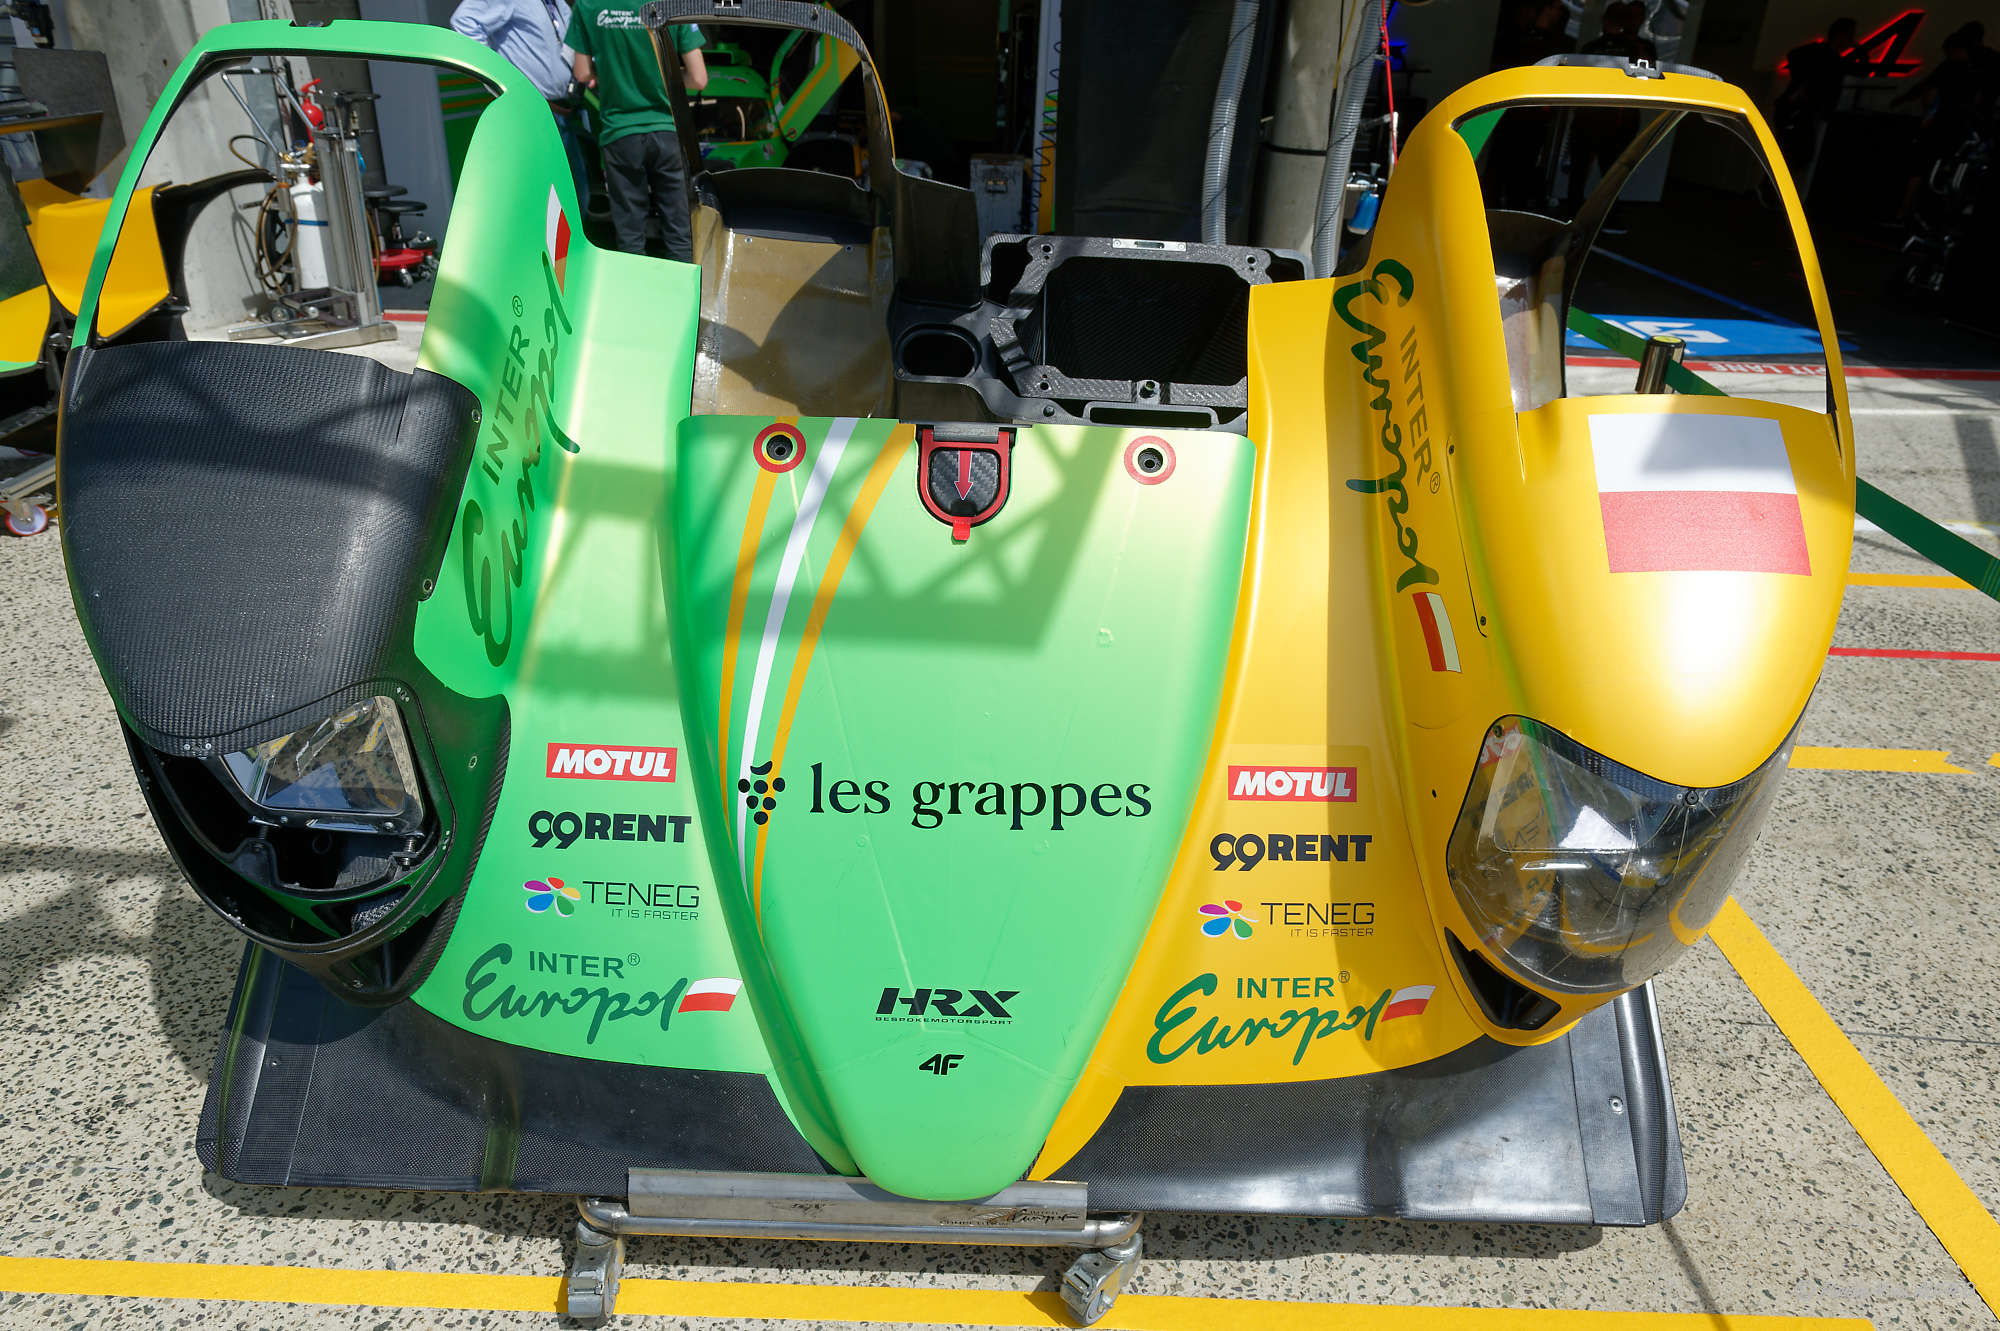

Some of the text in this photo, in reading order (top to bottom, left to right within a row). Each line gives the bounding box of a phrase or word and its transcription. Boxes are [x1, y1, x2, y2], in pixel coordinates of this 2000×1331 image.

[1333, 258, 1440, 593] Europol
[462, 250, 580, 668] Europol
[551, 748, 671, 777] MOTUL
[809, 762, 1152, 831] les grappes
[1233, 770, 1352, 797] MOTUL
[528, 810, 692, 849] 99RENT
[1209, 832, 1373, 872] 99RENT
[582, 880, 700, 908] TENEG
[611, 908, 699, 921] IT IS FASTER
[1260, 902, 1375, 926] TENEG
[1290, 928, 1374, 937] IT IS FASTER
[462, 943, 688, 1045] Europol
[876, 987, 1021, 1018] HRX
[1146, 973, 1392, 1066] Europol
[918, 1053, 965, 1076] 4F
